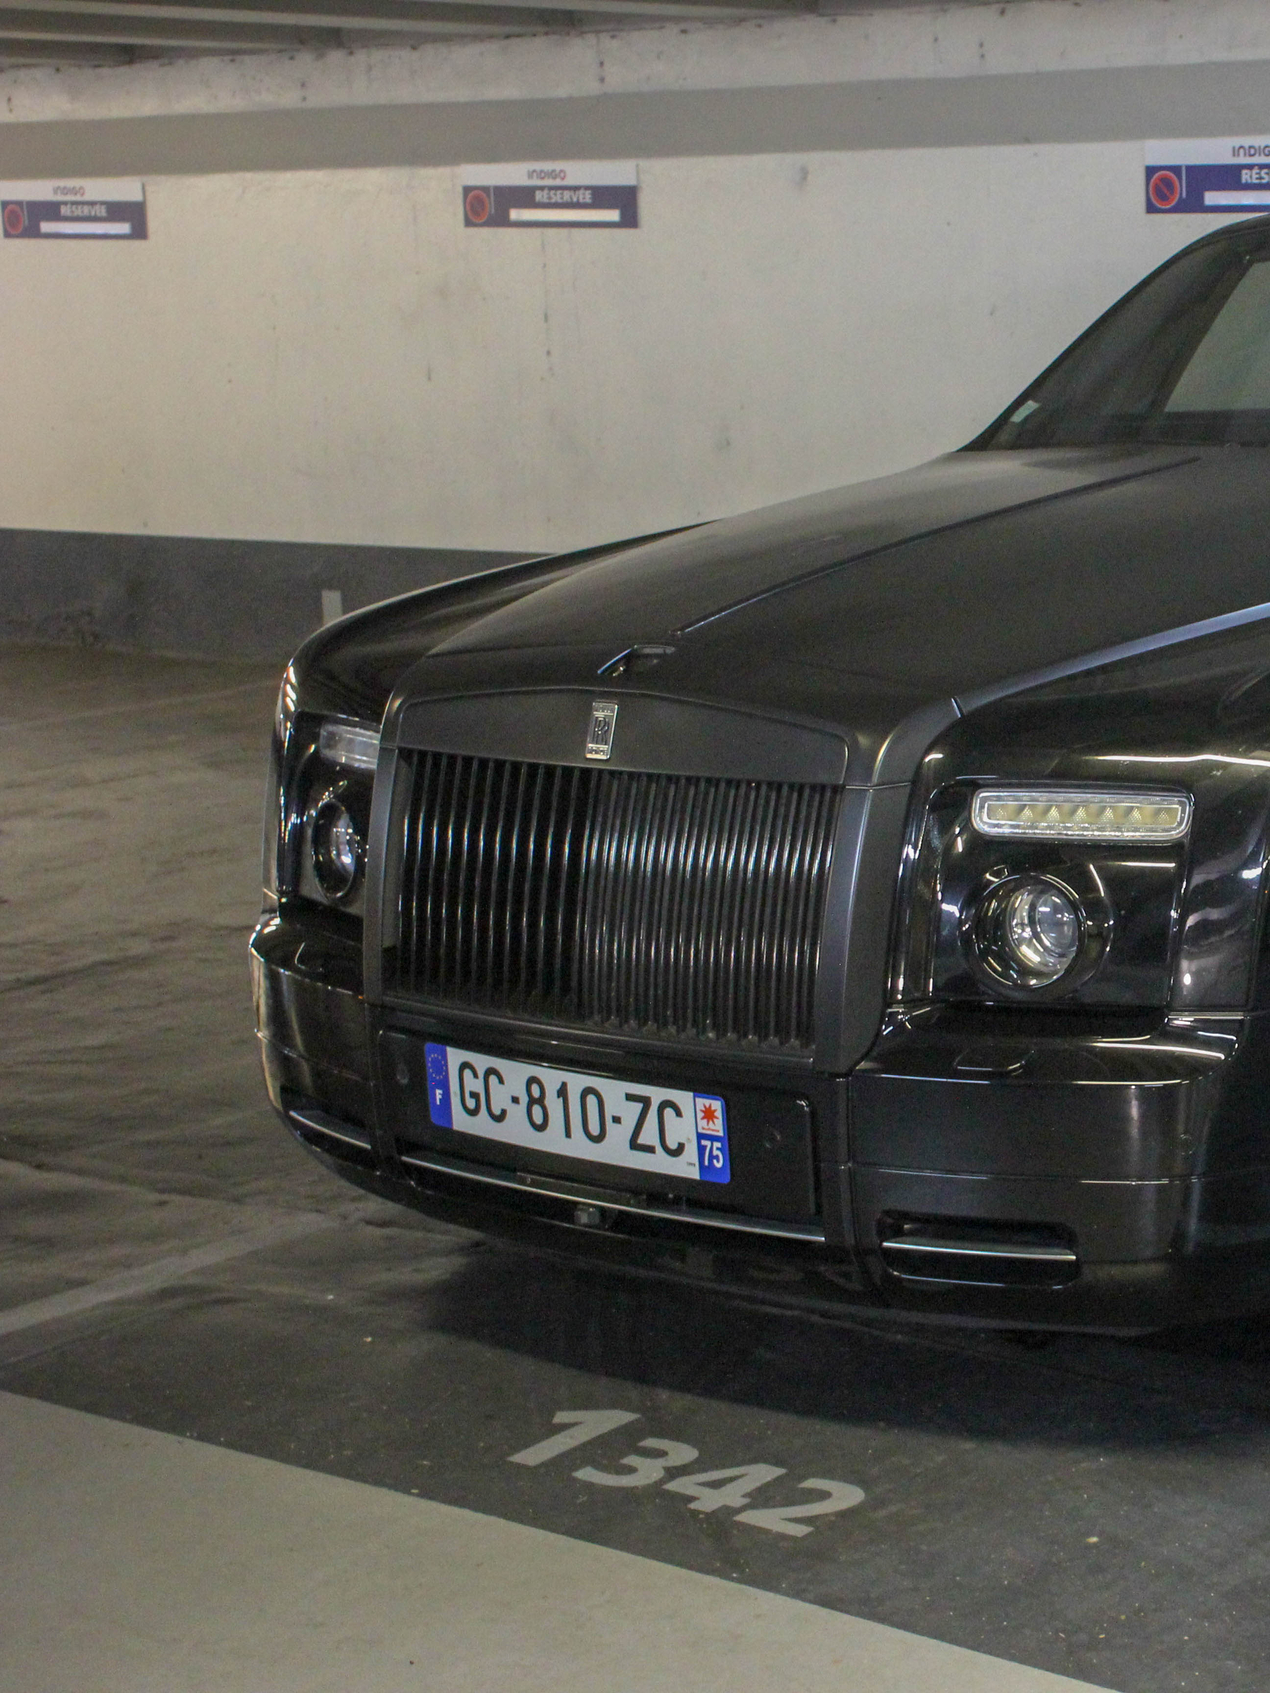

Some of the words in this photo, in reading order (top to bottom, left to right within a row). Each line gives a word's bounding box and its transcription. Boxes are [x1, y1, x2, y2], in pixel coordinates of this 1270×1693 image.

[534, 187, 593, 204] RÉSERVÉE
[60, 202, 107, 217] RÉSERVÉE
[435, 1088, 444, 1106] F
[457, 1060, 686, 1159] GC-810-ZC
[700, 1139, 724, 1168] 75
[505, 1409, 866, 1538] 1342
